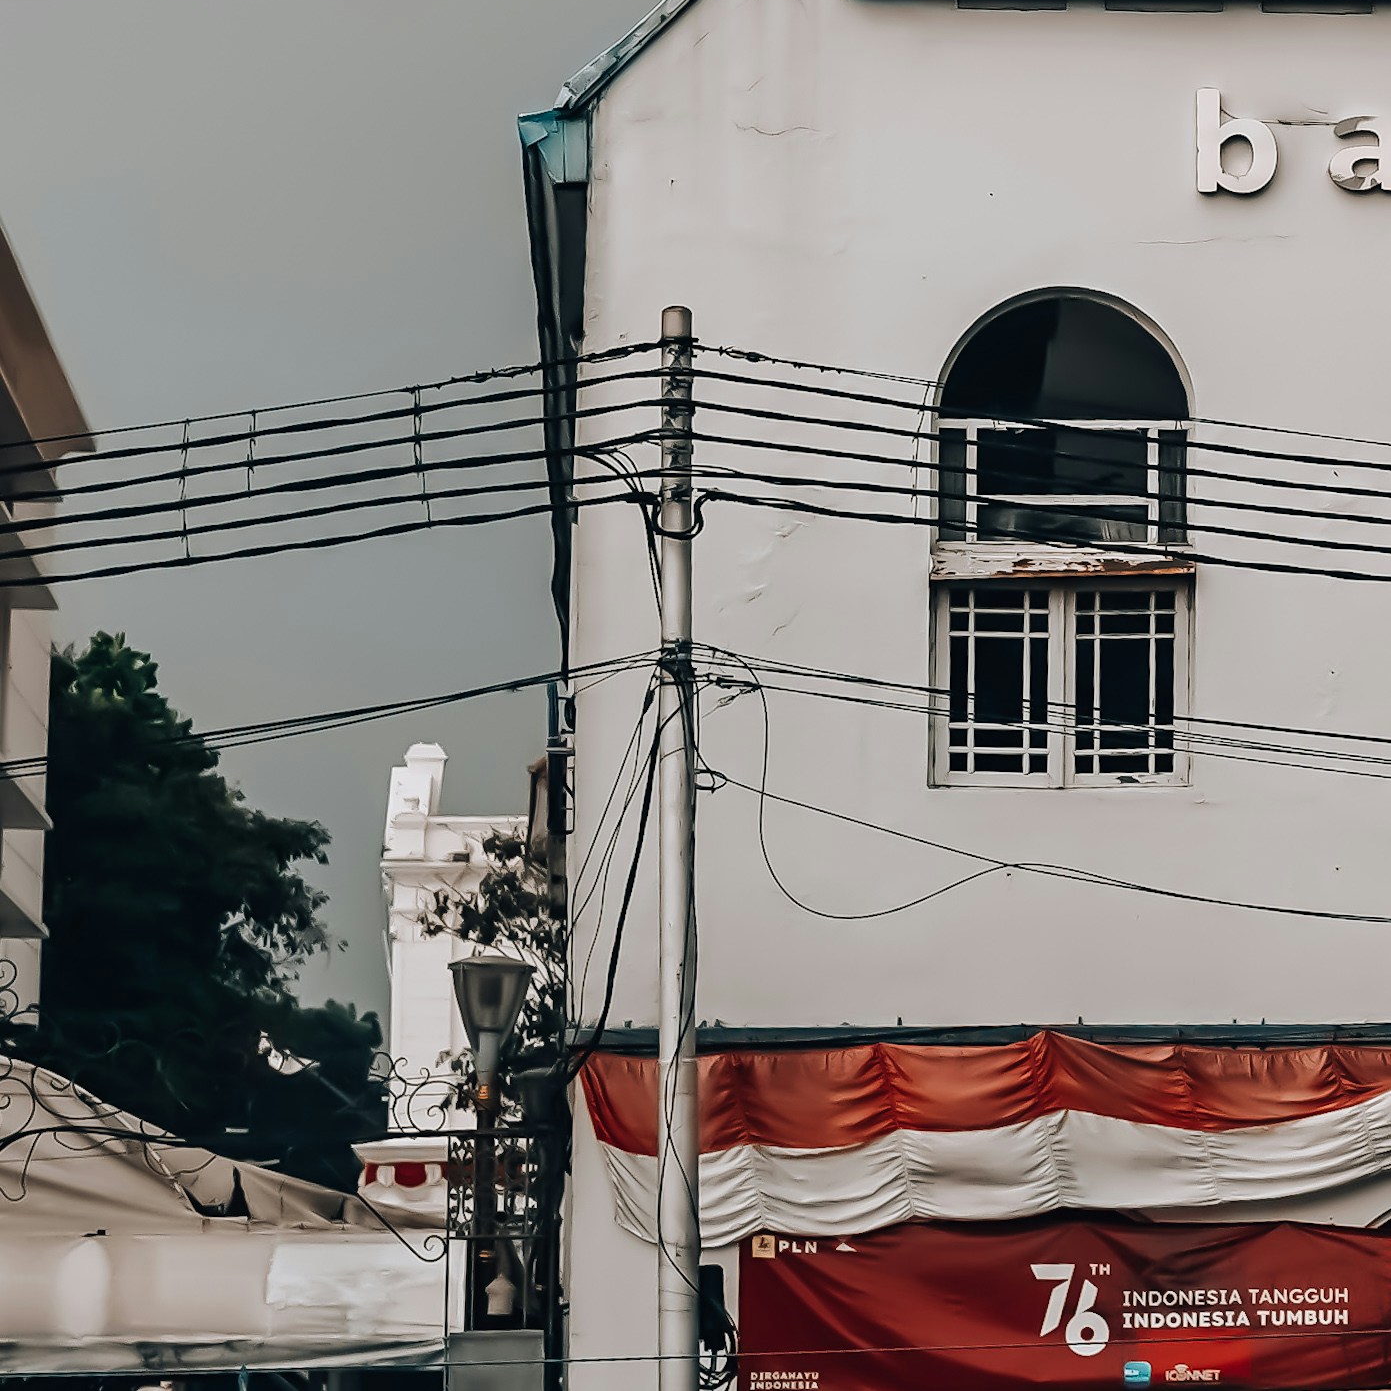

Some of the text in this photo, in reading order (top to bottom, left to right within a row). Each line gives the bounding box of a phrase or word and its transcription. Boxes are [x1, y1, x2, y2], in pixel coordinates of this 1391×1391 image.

[778, 1240, 818, 1254] PLN
[1122, 1287, 1349, 1307] INDONESIA TANGGUH
[1030, 1263, 1112, 1357] 76 TH
[1122, 1308, 1349, 1329] INDONESIA TUMBUH
[750, 1381, 819, 1391] INDONESIA
